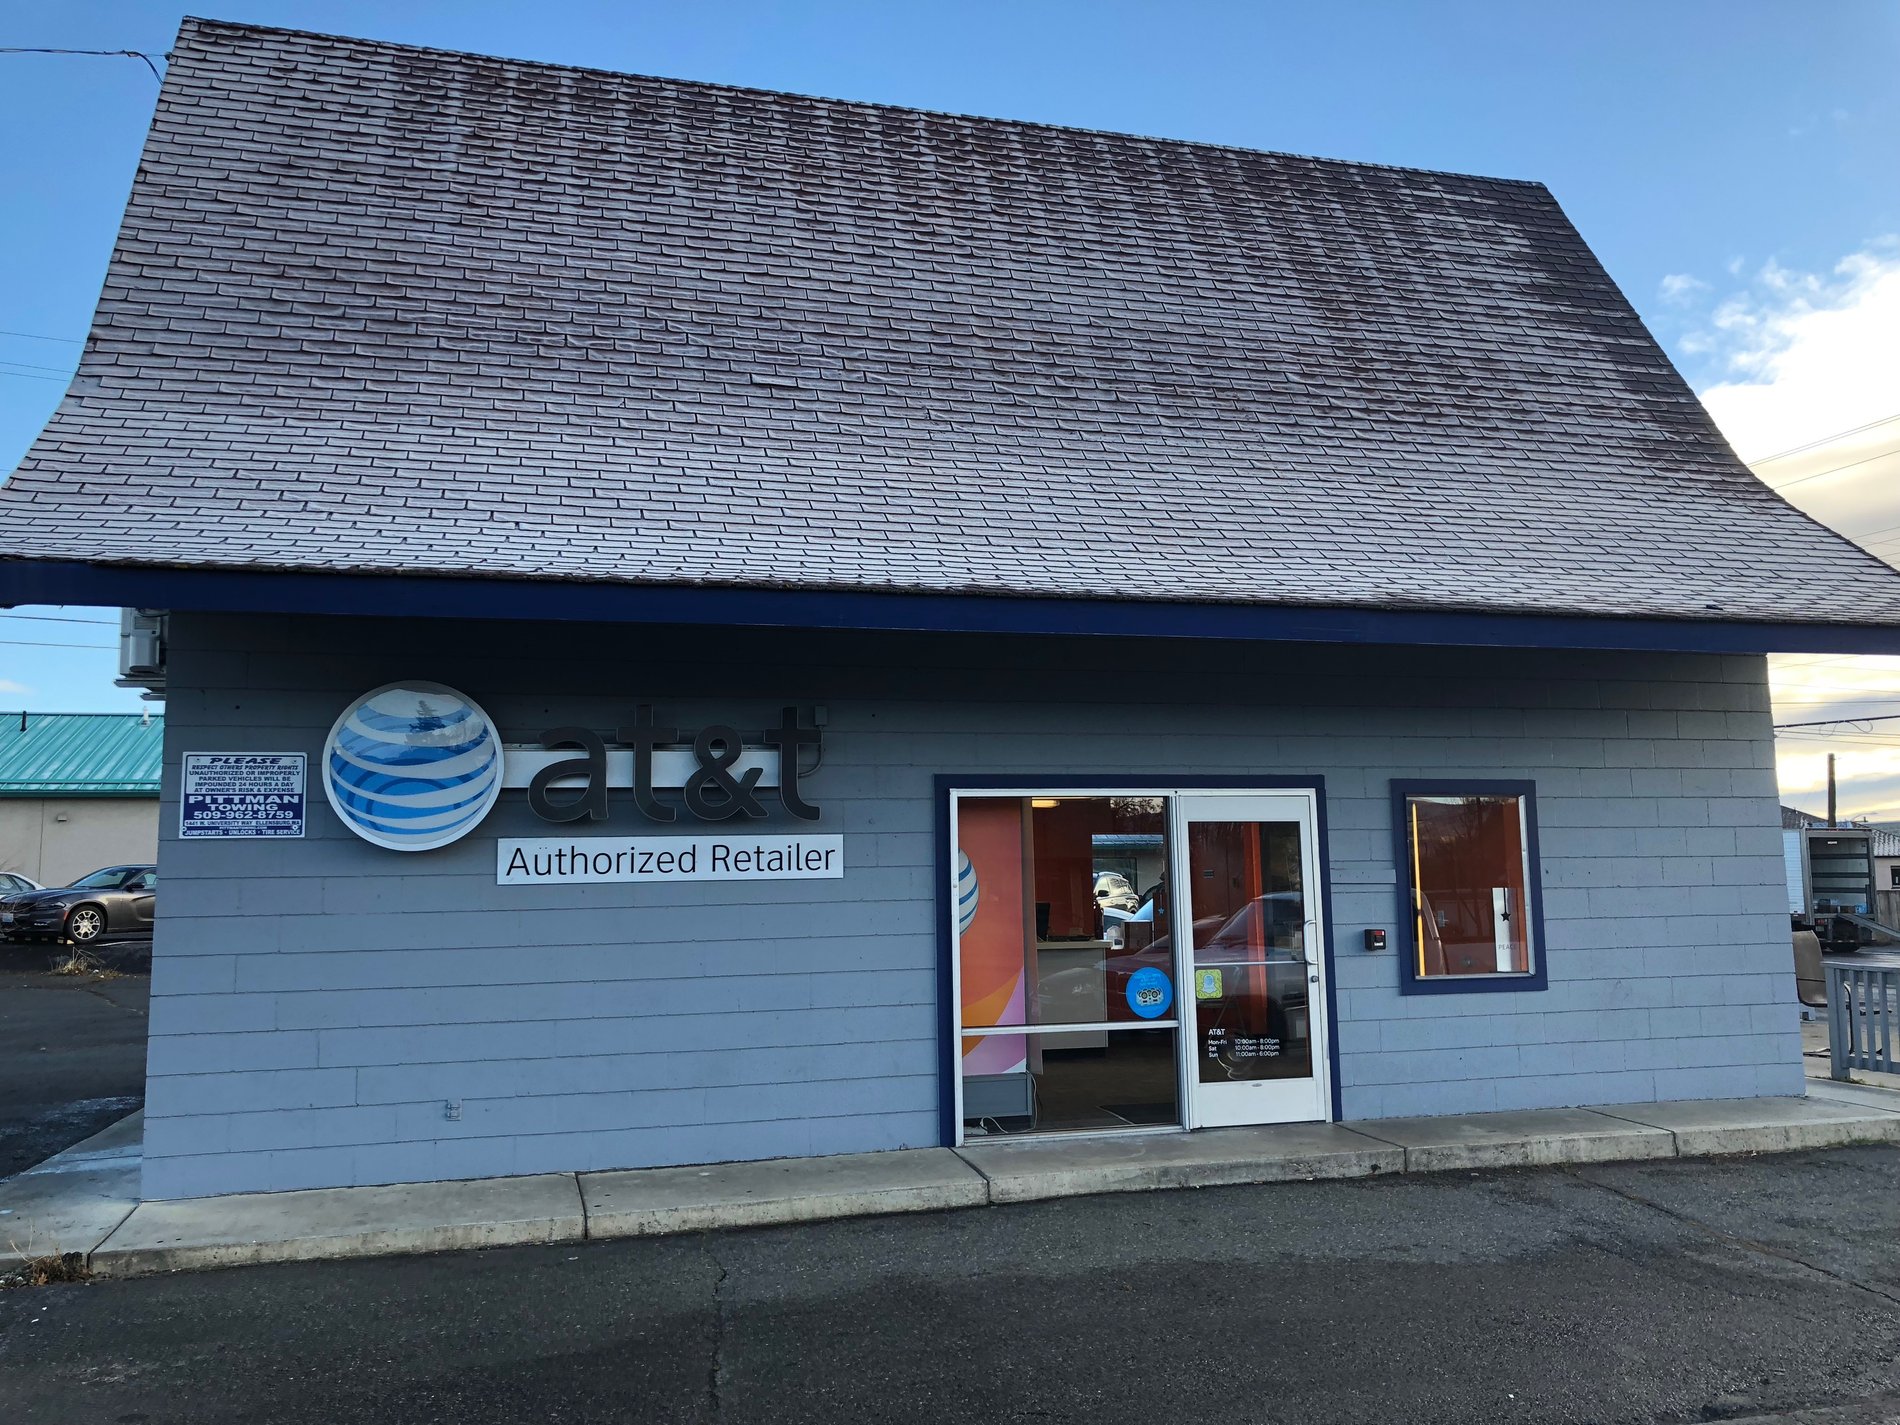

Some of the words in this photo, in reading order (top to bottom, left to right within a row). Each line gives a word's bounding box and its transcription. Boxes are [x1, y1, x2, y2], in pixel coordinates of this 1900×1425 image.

[528, 704, 822, 822] at&t
[188, 795, 299, 804] PITTMAN
[193, 811, 294, 819] 509-962-8759
[506, 844, 697, 877] Authorized
[711, 842, 836, 873] Retailer
